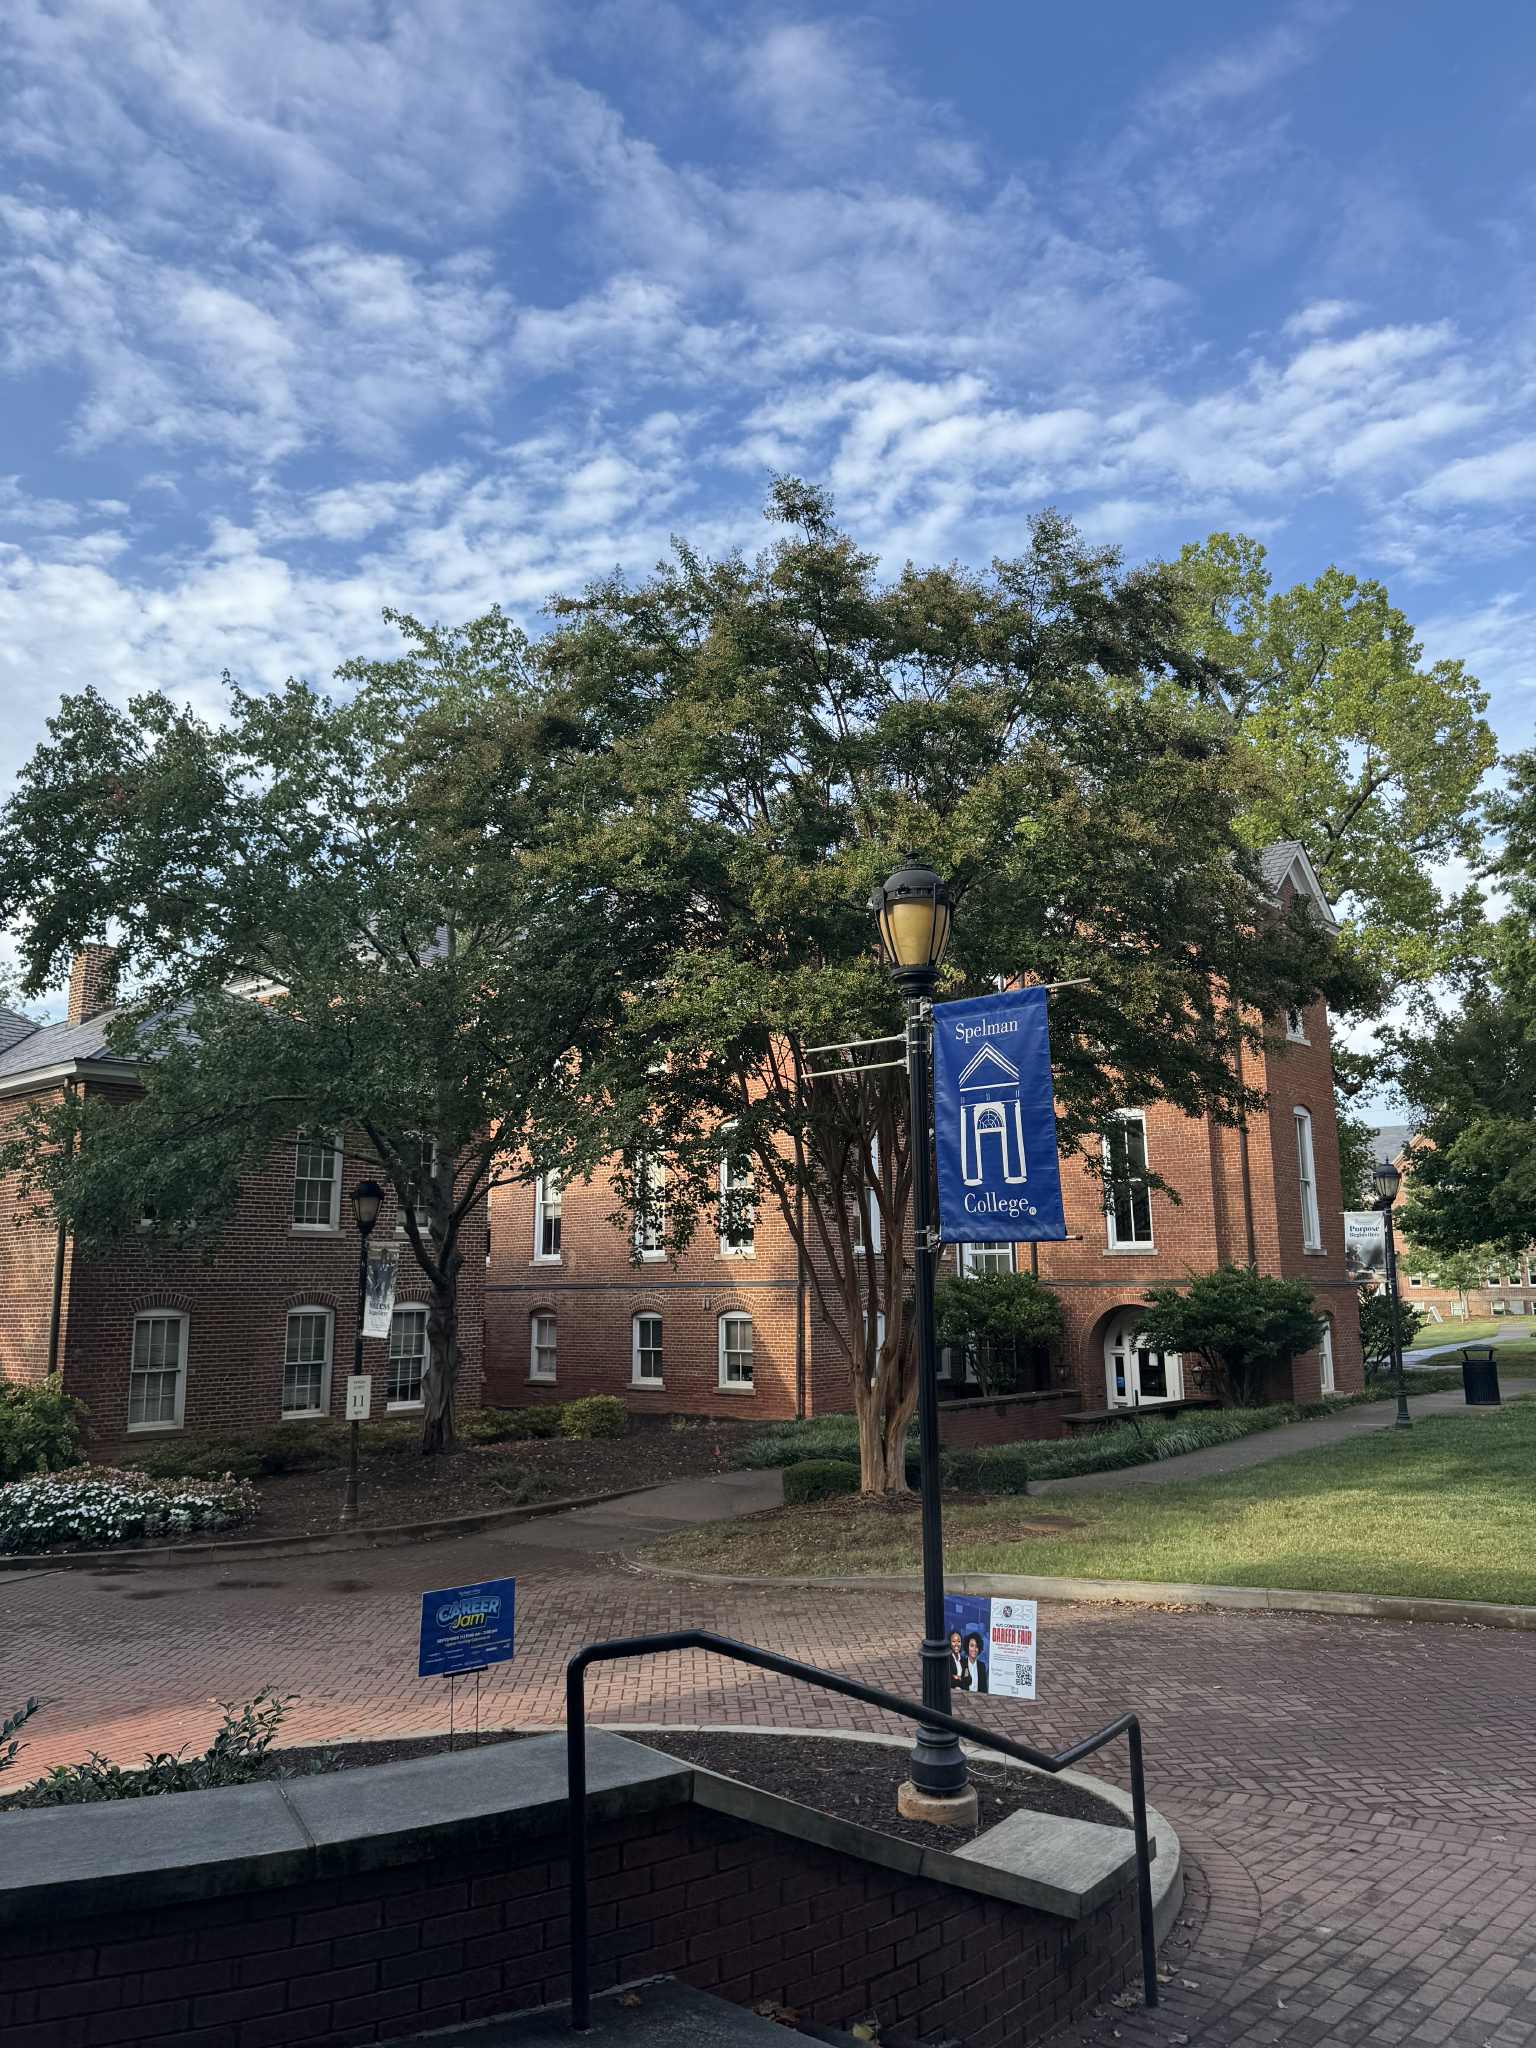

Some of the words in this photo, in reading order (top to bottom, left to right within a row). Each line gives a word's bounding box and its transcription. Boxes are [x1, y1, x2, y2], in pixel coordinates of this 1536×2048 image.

[955, 1019, 1018, 1043] Spelman
[352, 1395, 364, 1407] 11
[439, 1598, 500, 1622] CAREER
[452, 1612, 485, 1629] Jam
[992, 1628, 1016, 1644] CAREER
[1017, 1629, 1032, 1646] FAIR
